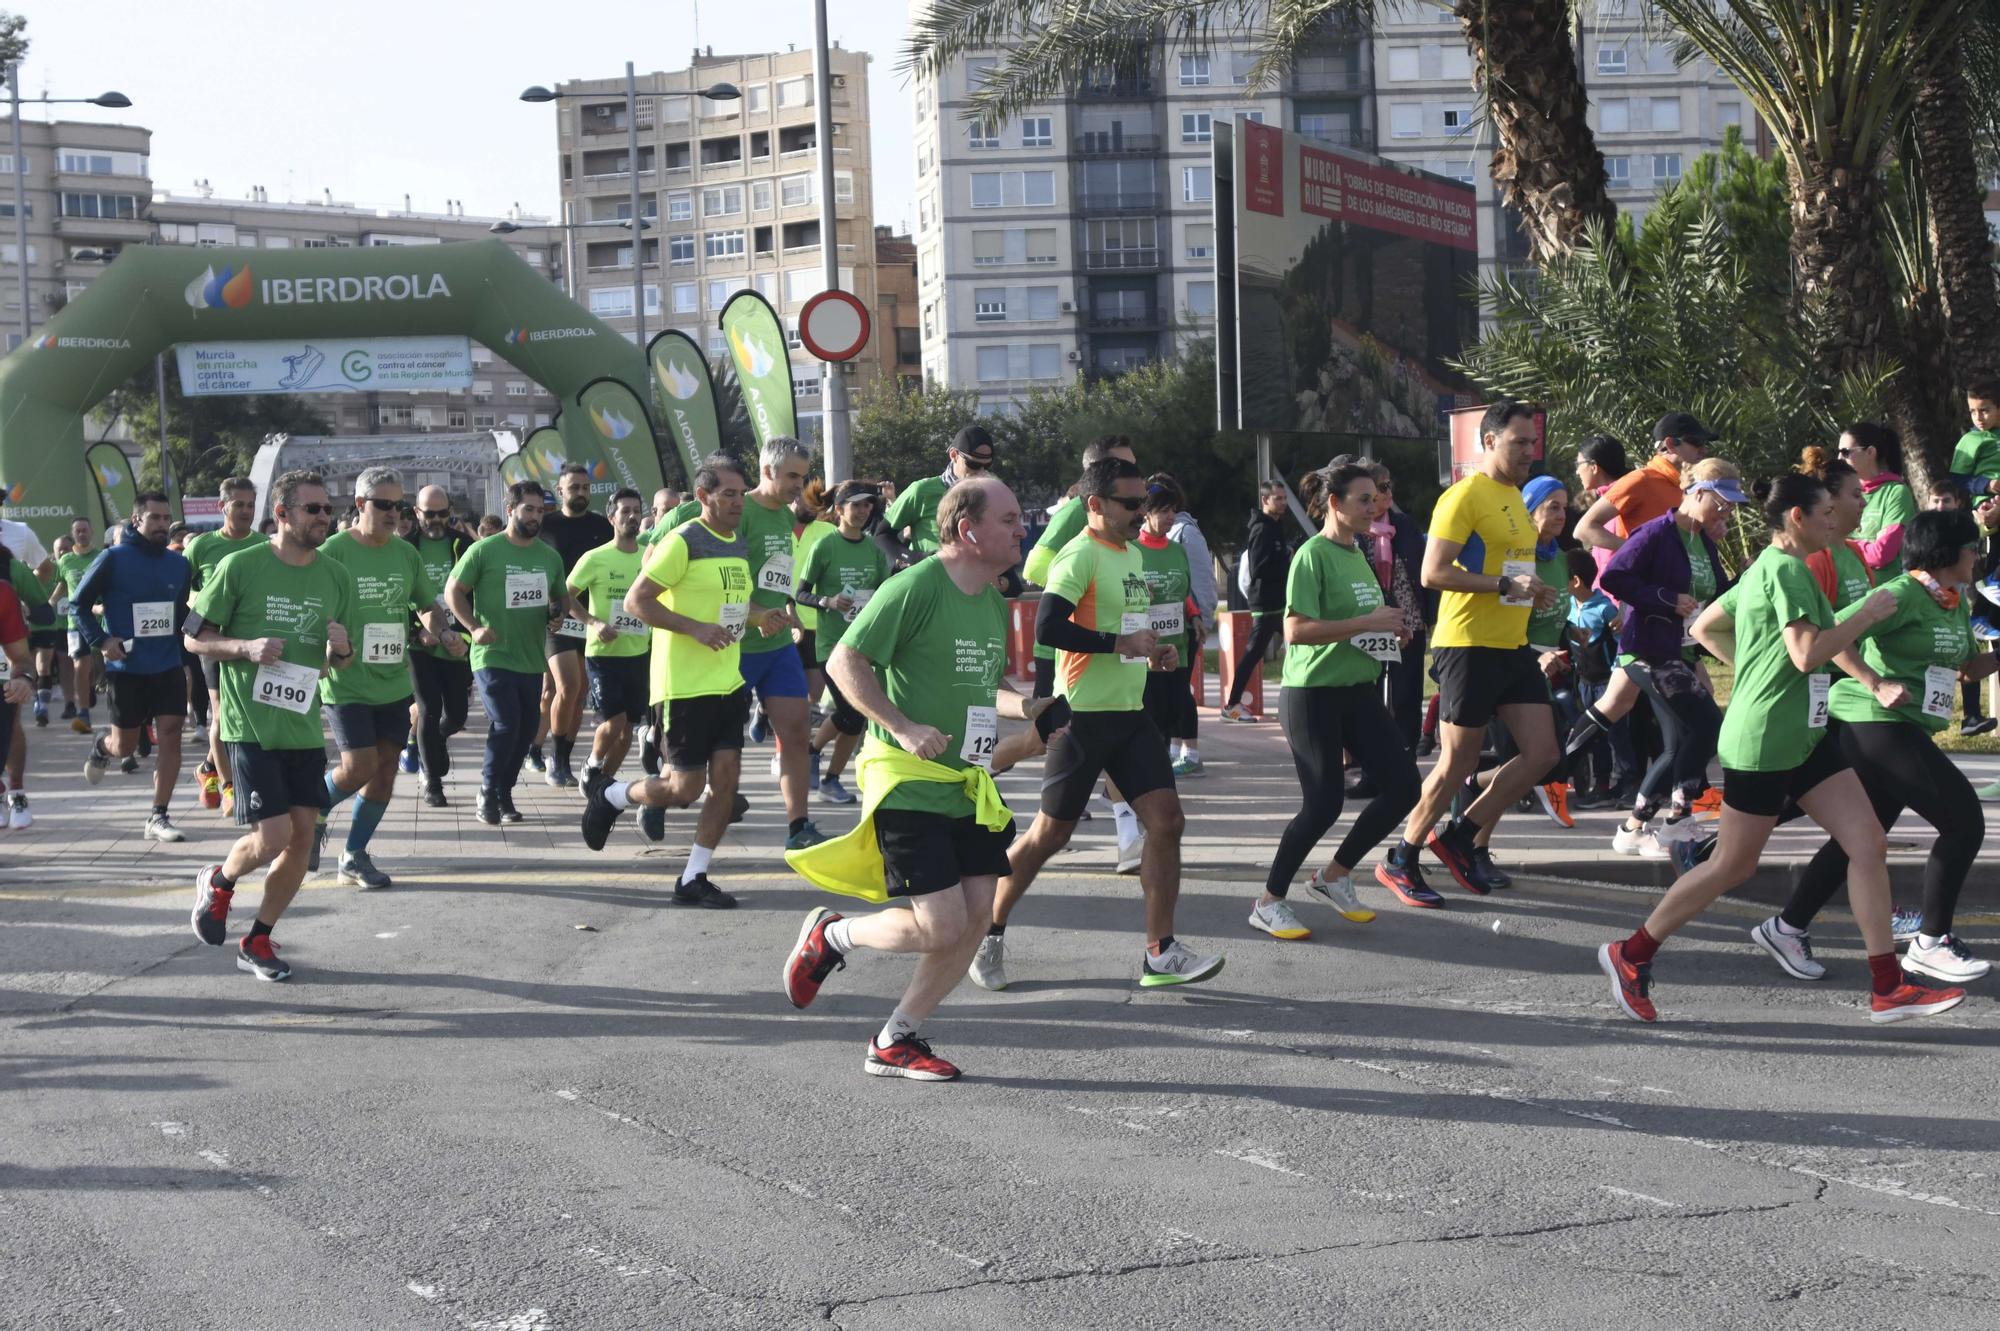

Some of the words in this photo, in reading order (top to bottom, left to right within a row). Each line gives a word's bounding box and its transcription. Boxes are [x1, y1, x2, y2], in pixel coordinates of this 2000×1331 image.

[1303, 156, 1342, 186] MURCIA
[1374, 180, 1385, 197] DE
[1439, 198, 1444, 211] Y
[1444, 201, 1472, 219] MEJORA
[1347, 195, 1358, 210] DE
[1359, 197, 1374, 214] LOS
[1416, 212, 1430, 228] DEL
[261, 273, 452, 305] IBERDROLA
[529, 327, 597, 342] IBERDROLA
[58, 336, 131, 349] IBERDROLA
[196, 350, 236, 360] Murcia
[377, 351, 422, 360] asociación
[214, 360, 257, 369] marcha
[377, 361, 406, 370] contra
[407, 361, 415, 369] el
[198, 371, 235, 380] contra
[444, 368, 473, 377] Murcia
[198, 379, 209, 390] el
[2, 505, 75, 518] IBERDROLA
[766, 570, 791, 587] 0780
[512, 589, 543, 601] 2428
[141, 619, 170, 630] 2208
[563, 620, 585, 632] 323
[615, 615, 643, 629] 2345
[1151, 618, 1179, 631] 0059
[955, 638, 977, 647] Murcia
[1359, 638, 1397, 652] 2235
[372, 643, 402, 656] 1196
[263, 681, 306, 703] 0190
[974, 736, 995, 754] 12
